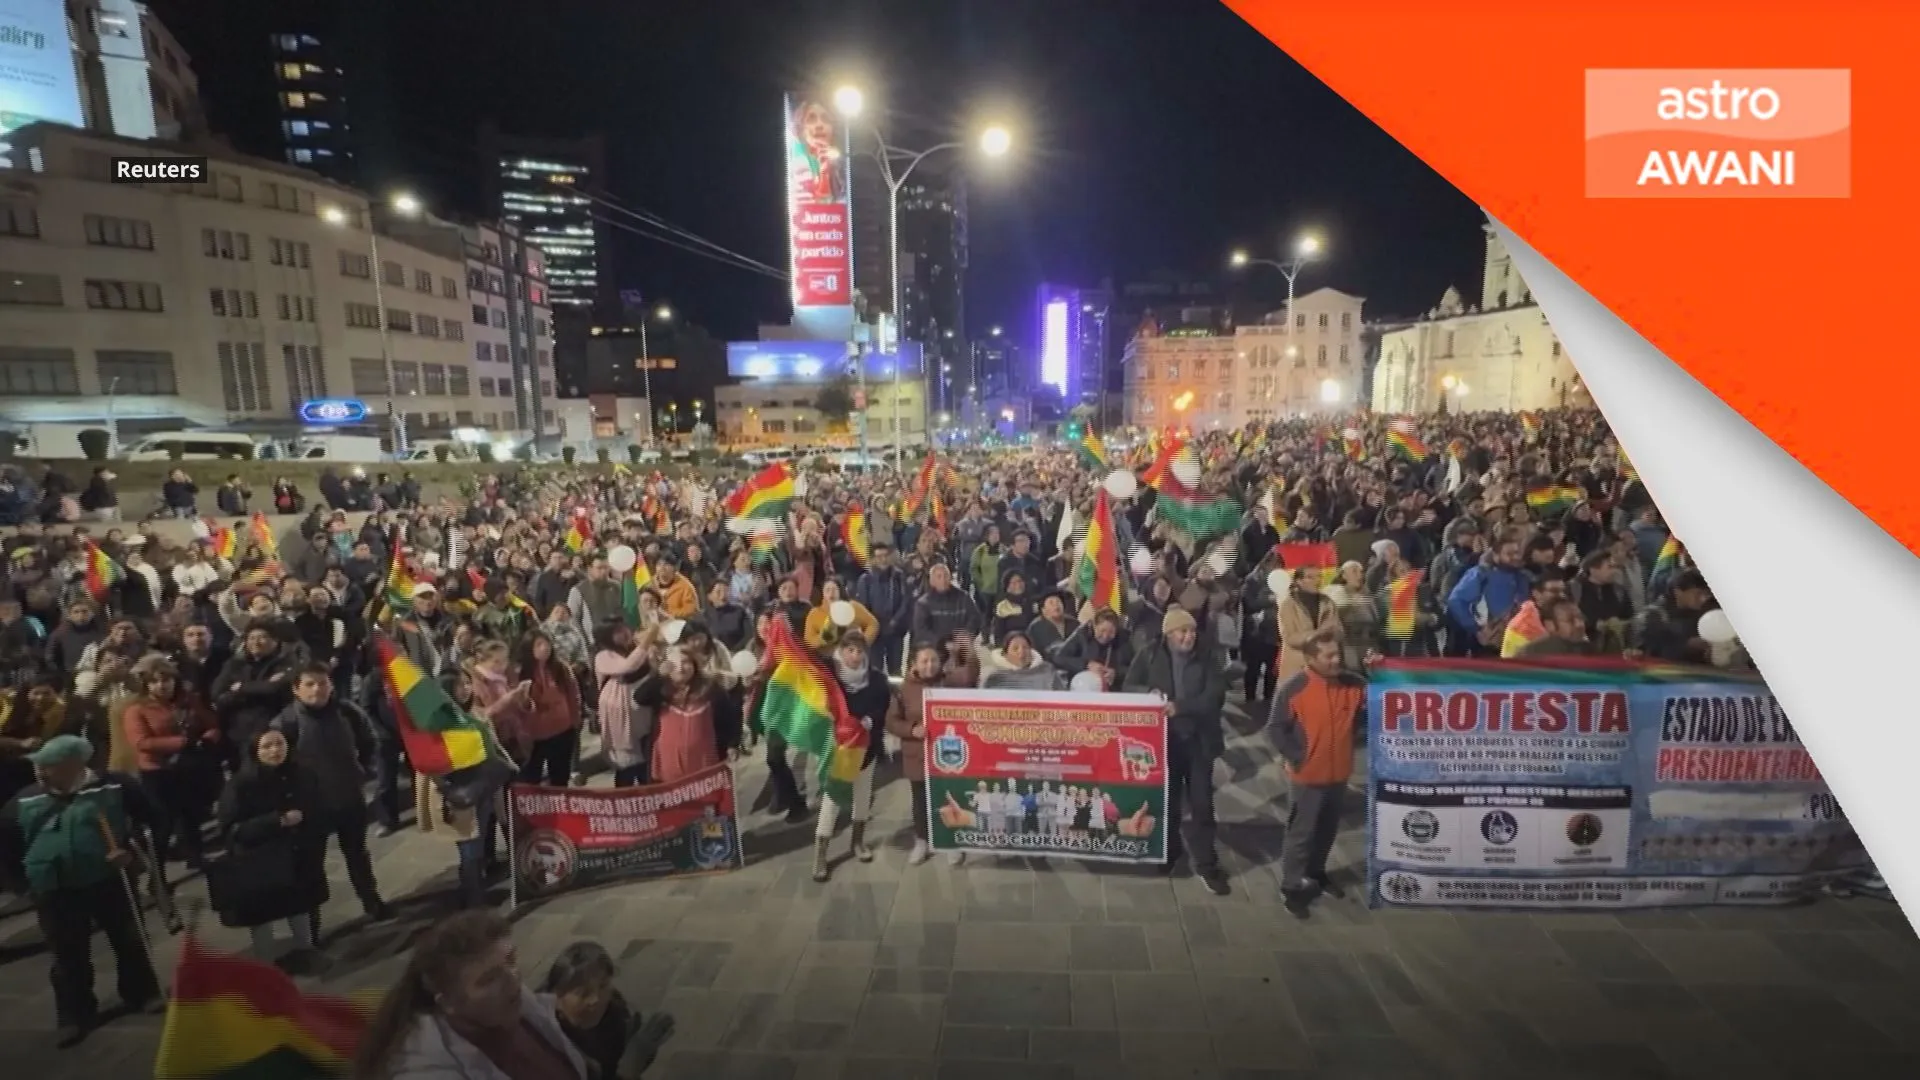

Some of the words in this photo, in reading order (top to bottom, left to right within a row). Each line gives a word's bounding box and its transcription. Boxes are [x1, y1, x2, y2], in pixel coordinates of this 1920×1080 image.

[801, 211, 841, 224] Juntos
[801, 246, 844, 259] partido
[1382, 690, 1630, 733] PROTESTA
[1661, 697, 1739, 742] ESTADO
[1743, 697, 1767, 742] DE
[1658, 748, 1783, 780] PRESIDENTE
[517, 793, 568, 815] COMITÉ
[615, 770, 730, 815] INTERPROVINCIAL
[589, 814, 658, 834] FEMENINO
[955, 831, 1008, 846] SOMOS
[1009, 833, 1090, 850] CHUKUTAS
